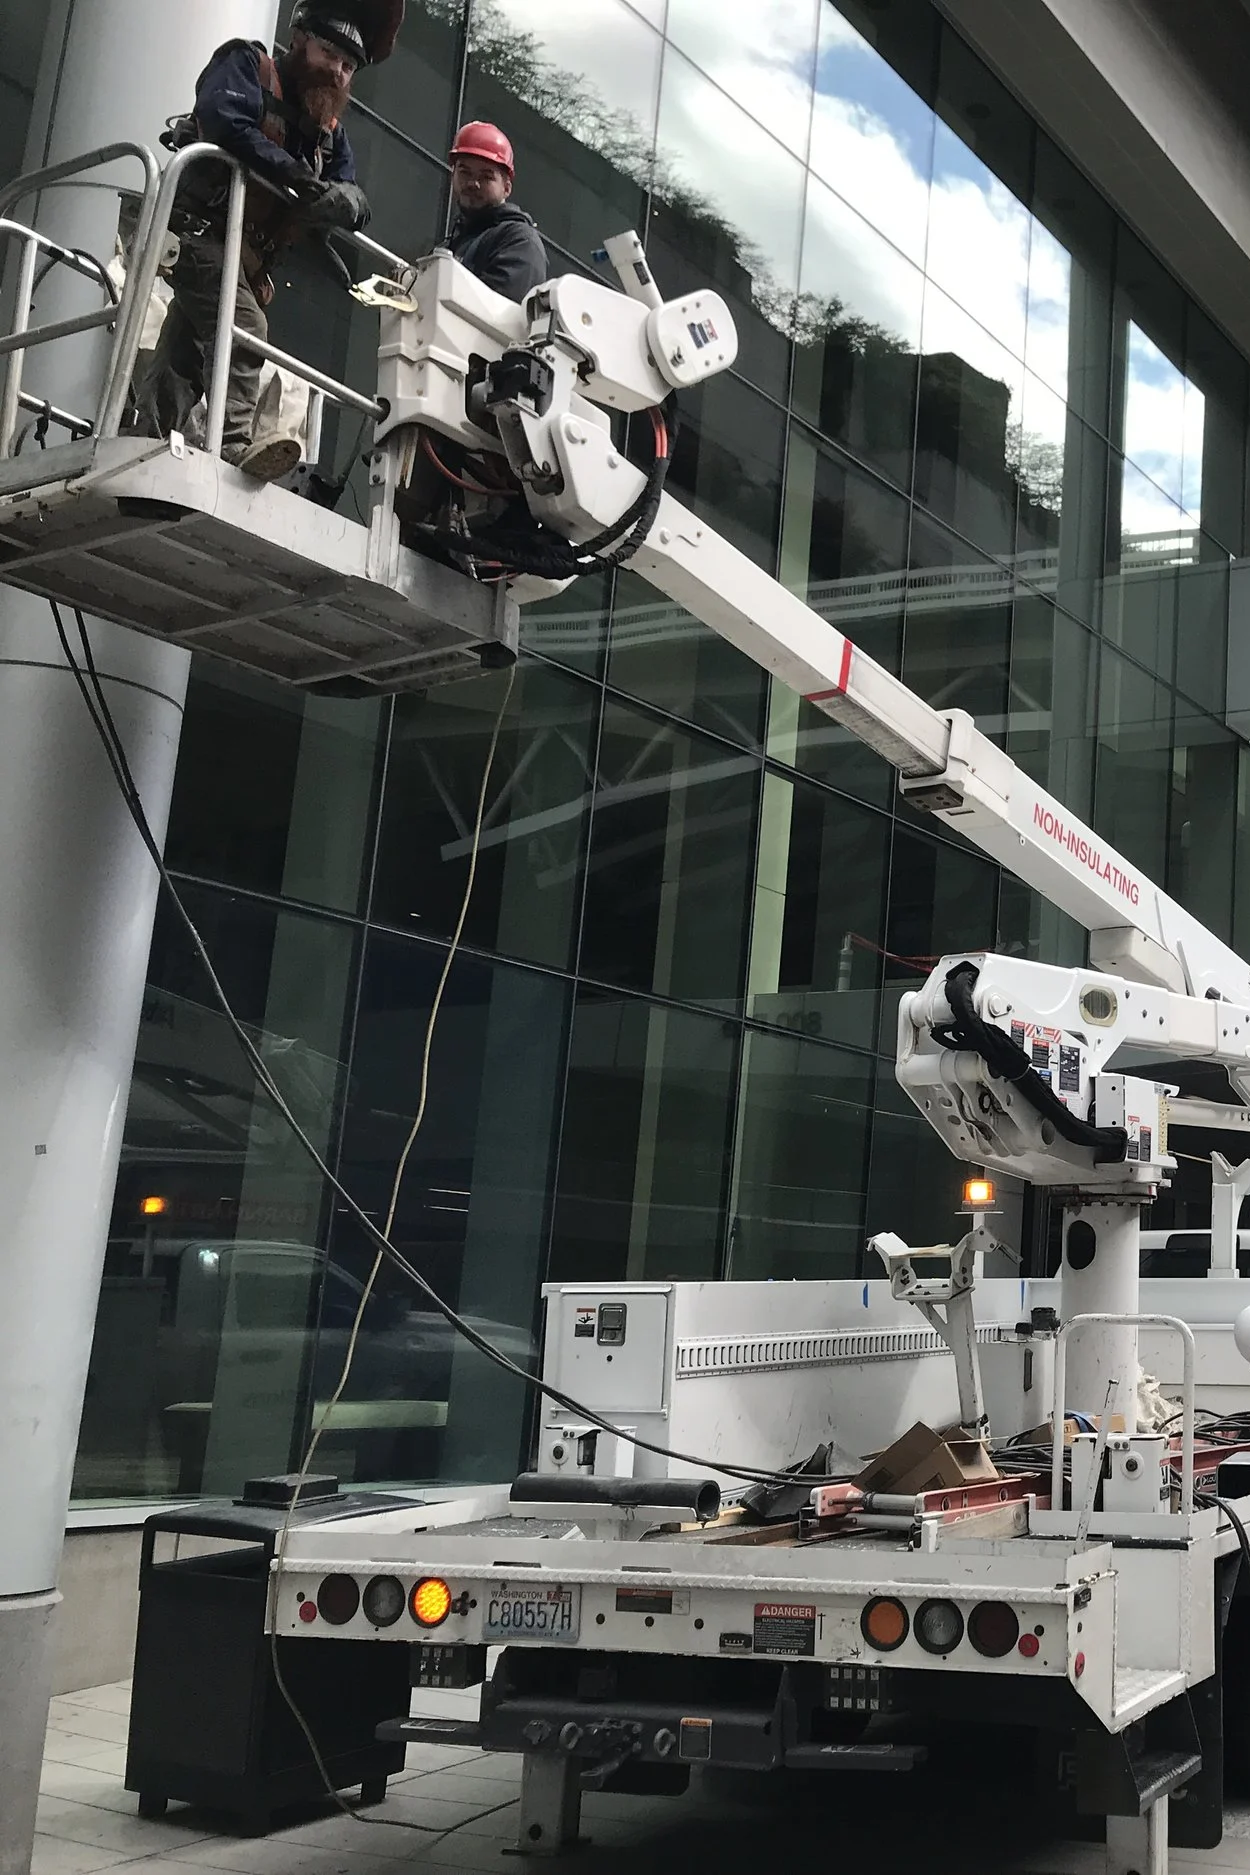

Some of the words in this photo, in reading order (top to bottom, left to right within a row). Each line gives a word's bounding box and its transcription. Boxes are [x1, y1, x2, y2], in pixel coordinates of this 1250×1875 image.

[1033, 803, 1139, 906] NON-INSULATING
[490, 1590, 543, 1600] WASHINGTON
[488, 1600, 572, 1630] C80557H
[770, 1606, 812, 1617] DANGER
